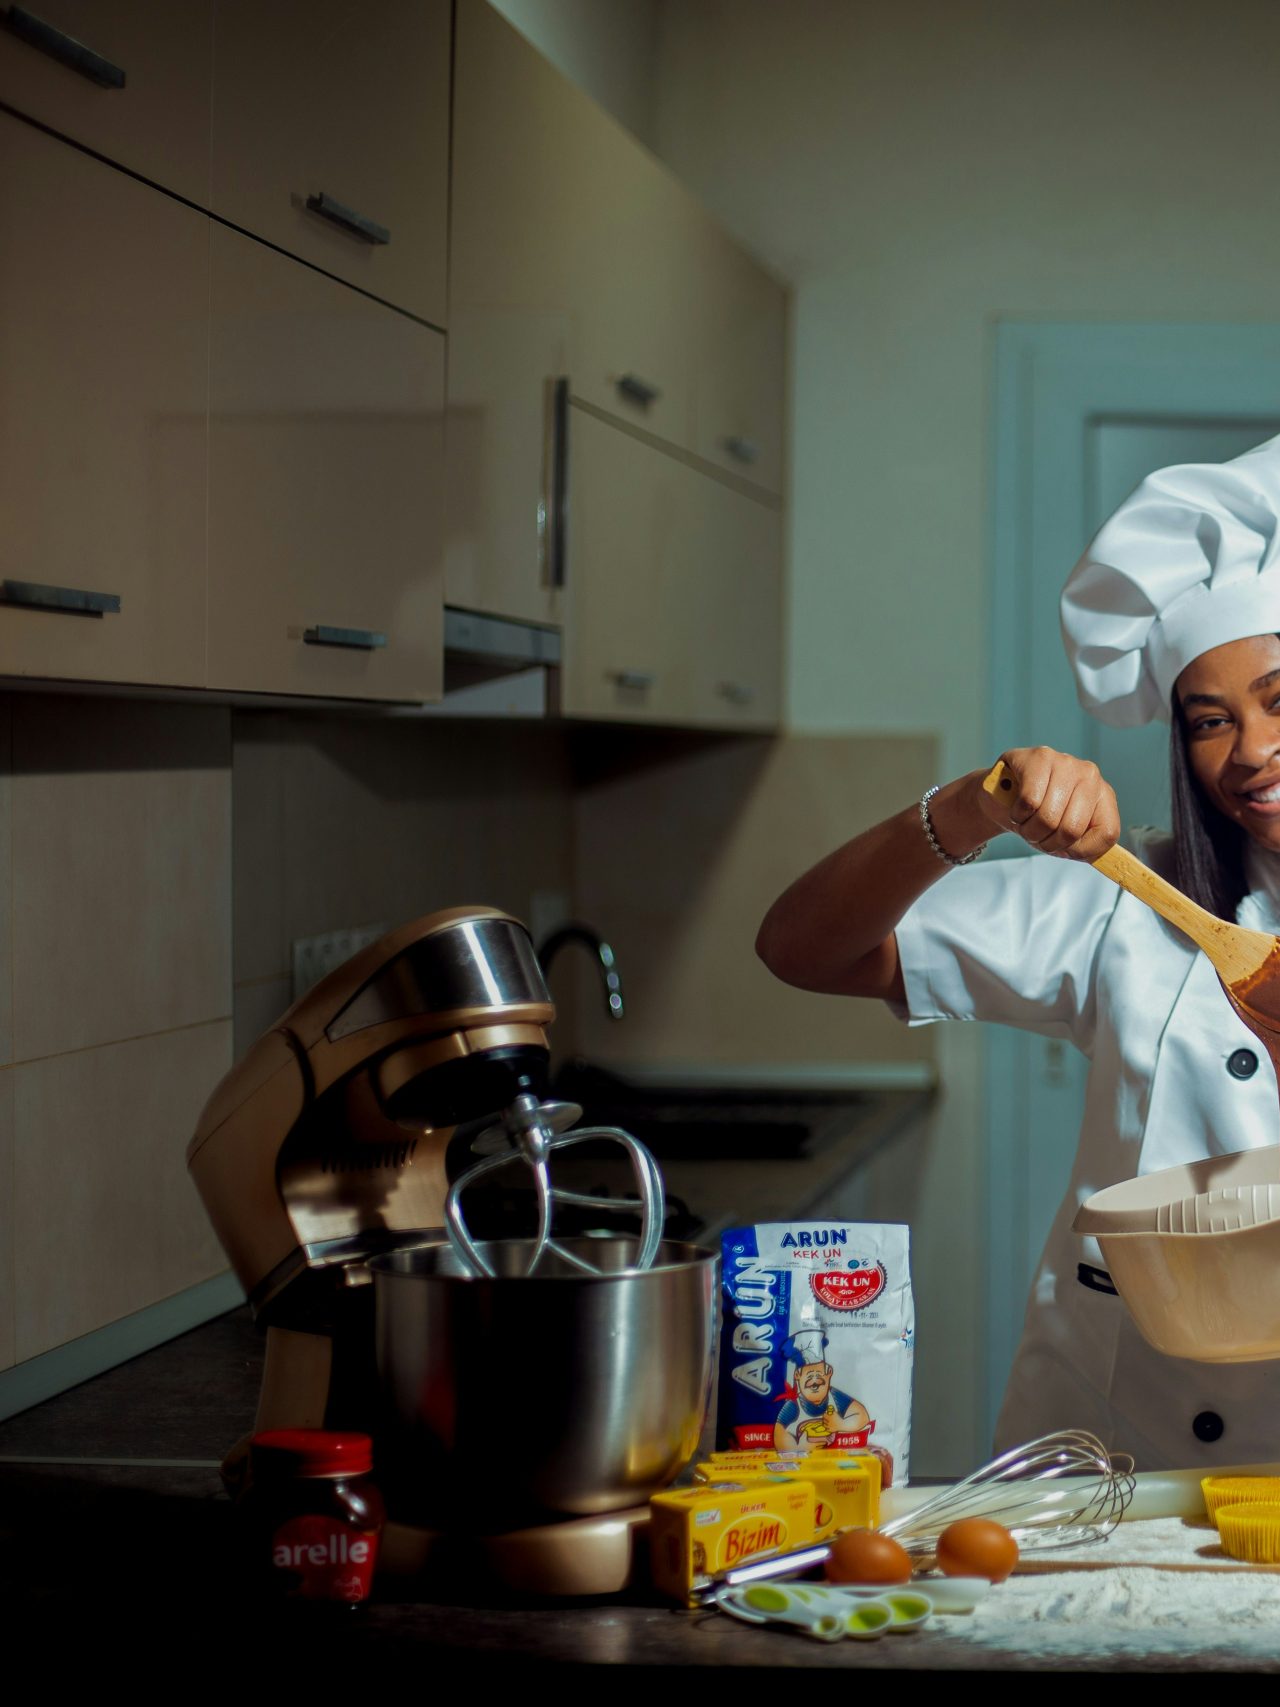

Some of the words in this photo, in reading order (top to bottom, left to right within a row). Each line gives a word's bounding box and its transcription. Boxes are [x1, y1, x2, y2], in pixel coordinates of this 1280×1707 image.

[780, 1228, 848, 1249] ARUN
[793, 1249, 821, 1260] KEK
[823, 1248, 842, 1259] UN
[823, 1276, 849, 1287] KEK
[853, 1277, 871, 1287] UN
[731, 1257, 777, 1396] ARUN
[744, 1432, 771, 1442] SINCE
[836, 1436, 860, 1446] 1958
[725, 1521, 781, 1564] Bizim
